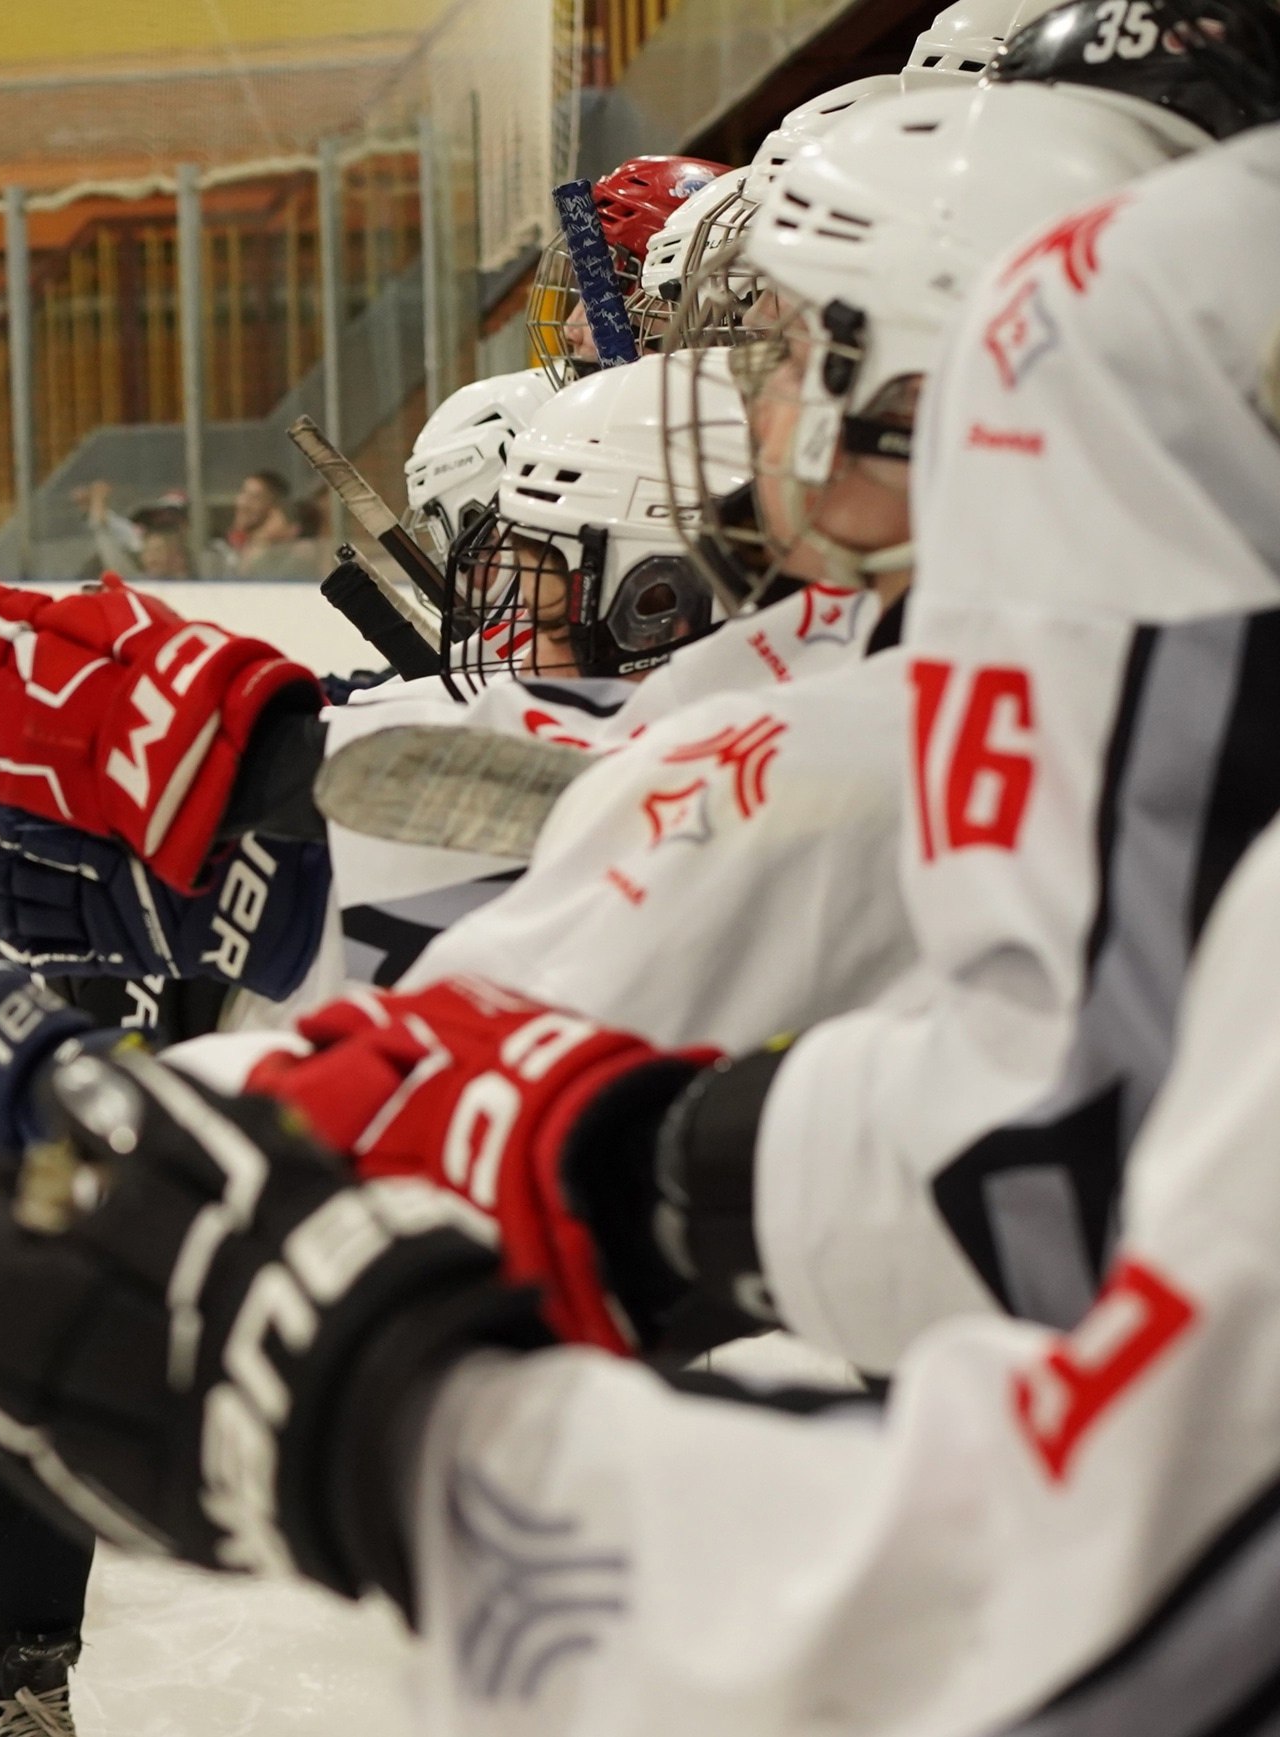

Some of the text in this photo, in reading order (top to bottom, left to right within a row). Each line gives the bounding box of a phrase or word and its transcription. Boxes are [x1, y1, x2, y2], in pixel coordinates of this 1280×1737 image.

[1083, 0, 1159, 64] 35
[618, 653, 670, 675] CCM
[746, 630, 794, 684] Запа
[105, 622, 232, 811] CM
